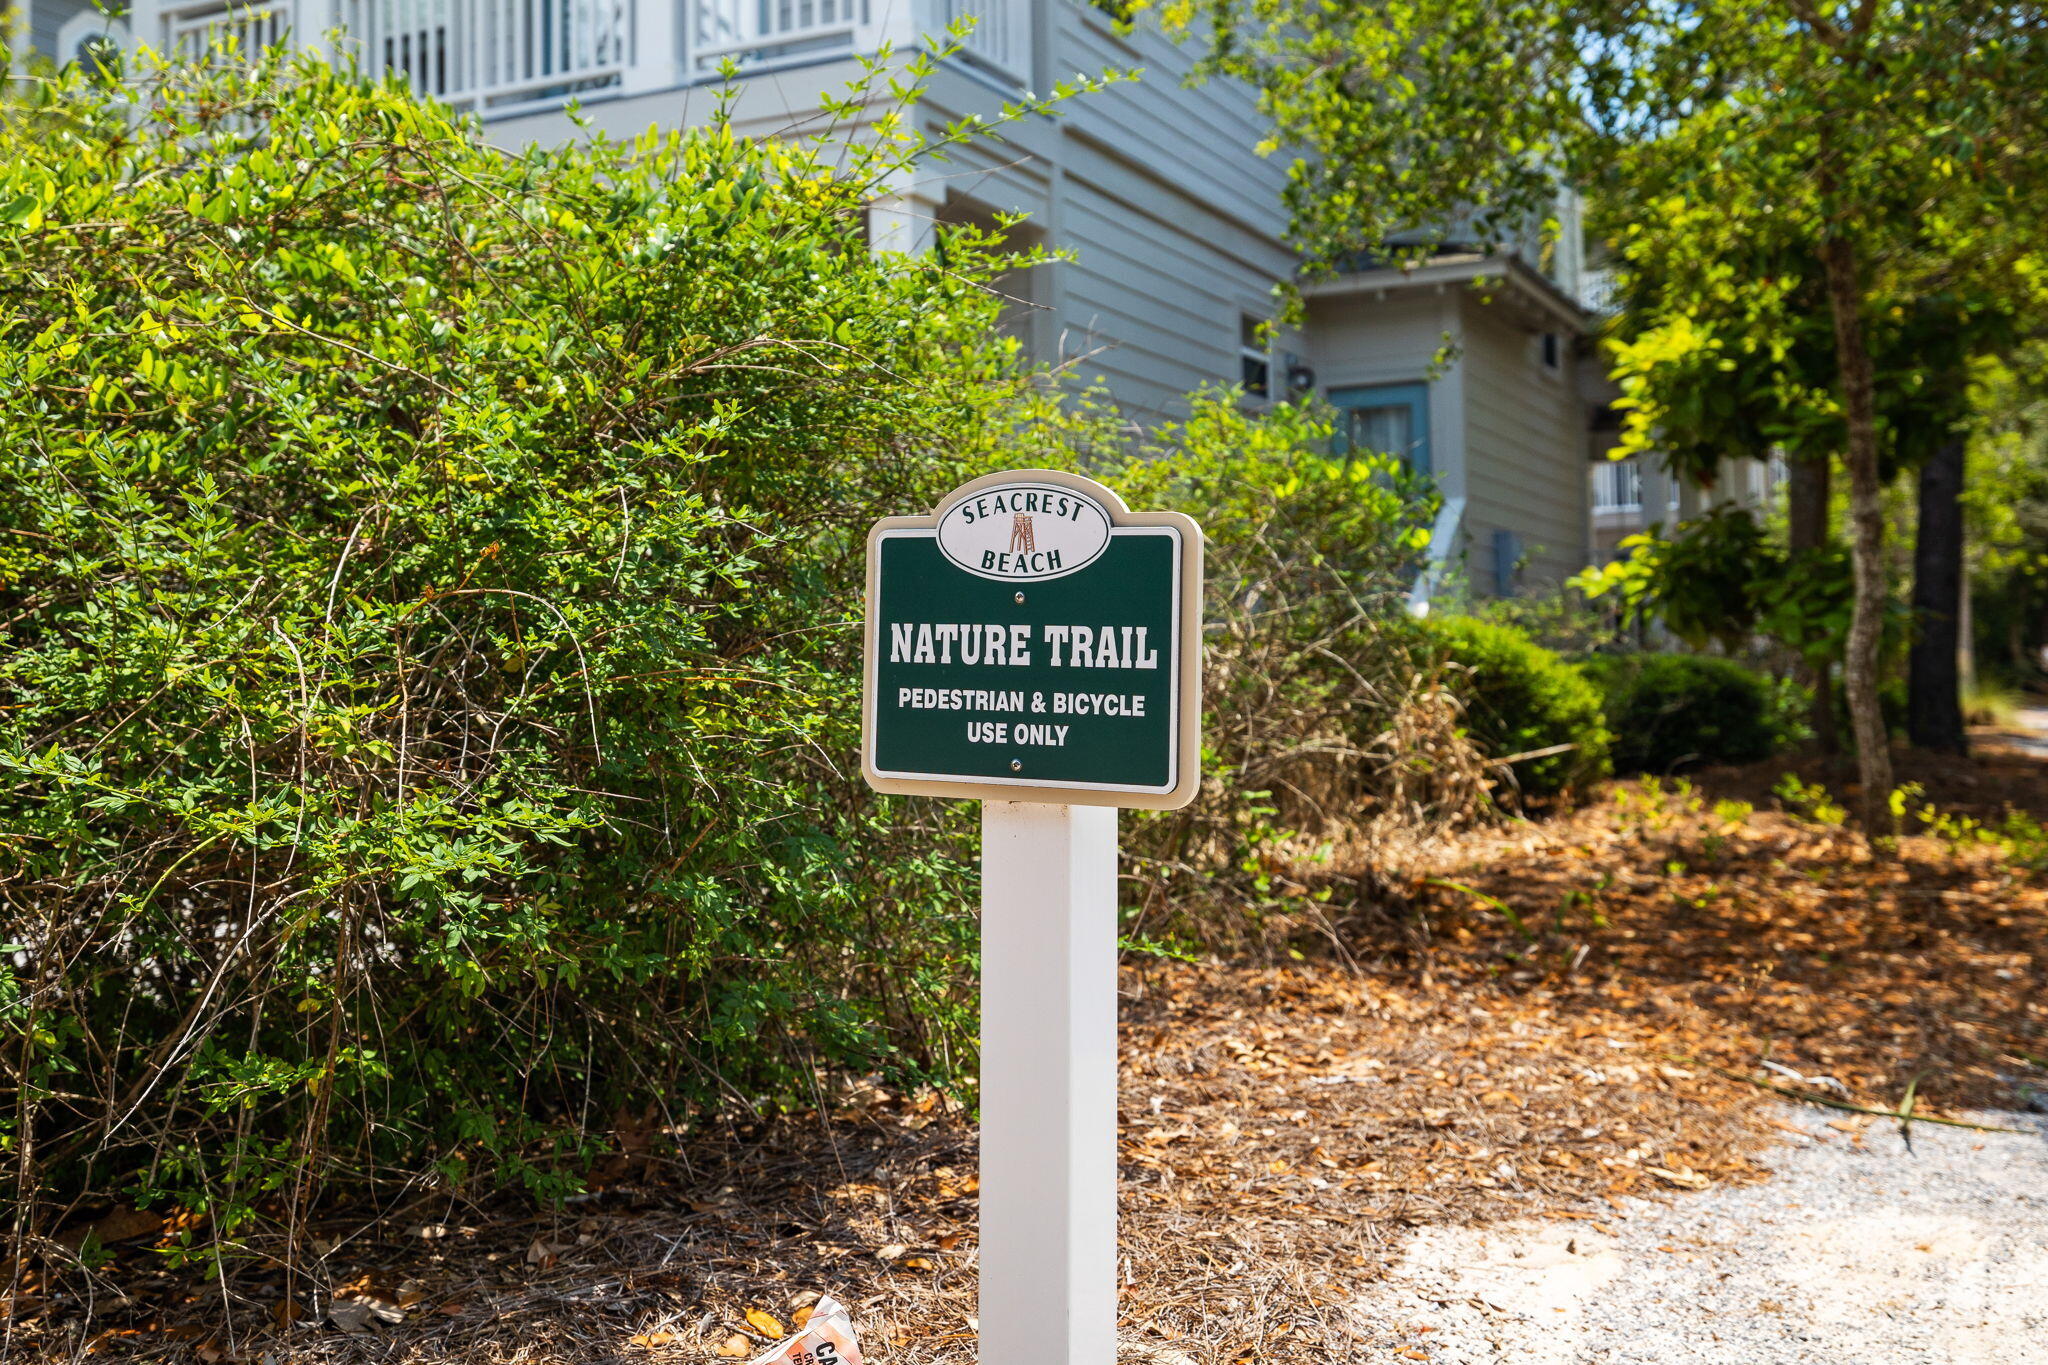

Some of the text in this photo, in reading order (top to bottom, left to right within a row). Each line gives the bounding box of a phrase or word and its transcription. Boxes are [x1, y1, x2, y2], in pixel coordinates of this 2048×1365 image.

[962, 492, 1084, 524] SEACREST
[981, 549, 1062, 573] BEACH
[890, 623, 1158, 669] NATURE TRAIL
[898, 687, 1146, 717] PEDESTRIAN & BICYCLE
[967, 722, 1069, 747] USE ONLY
